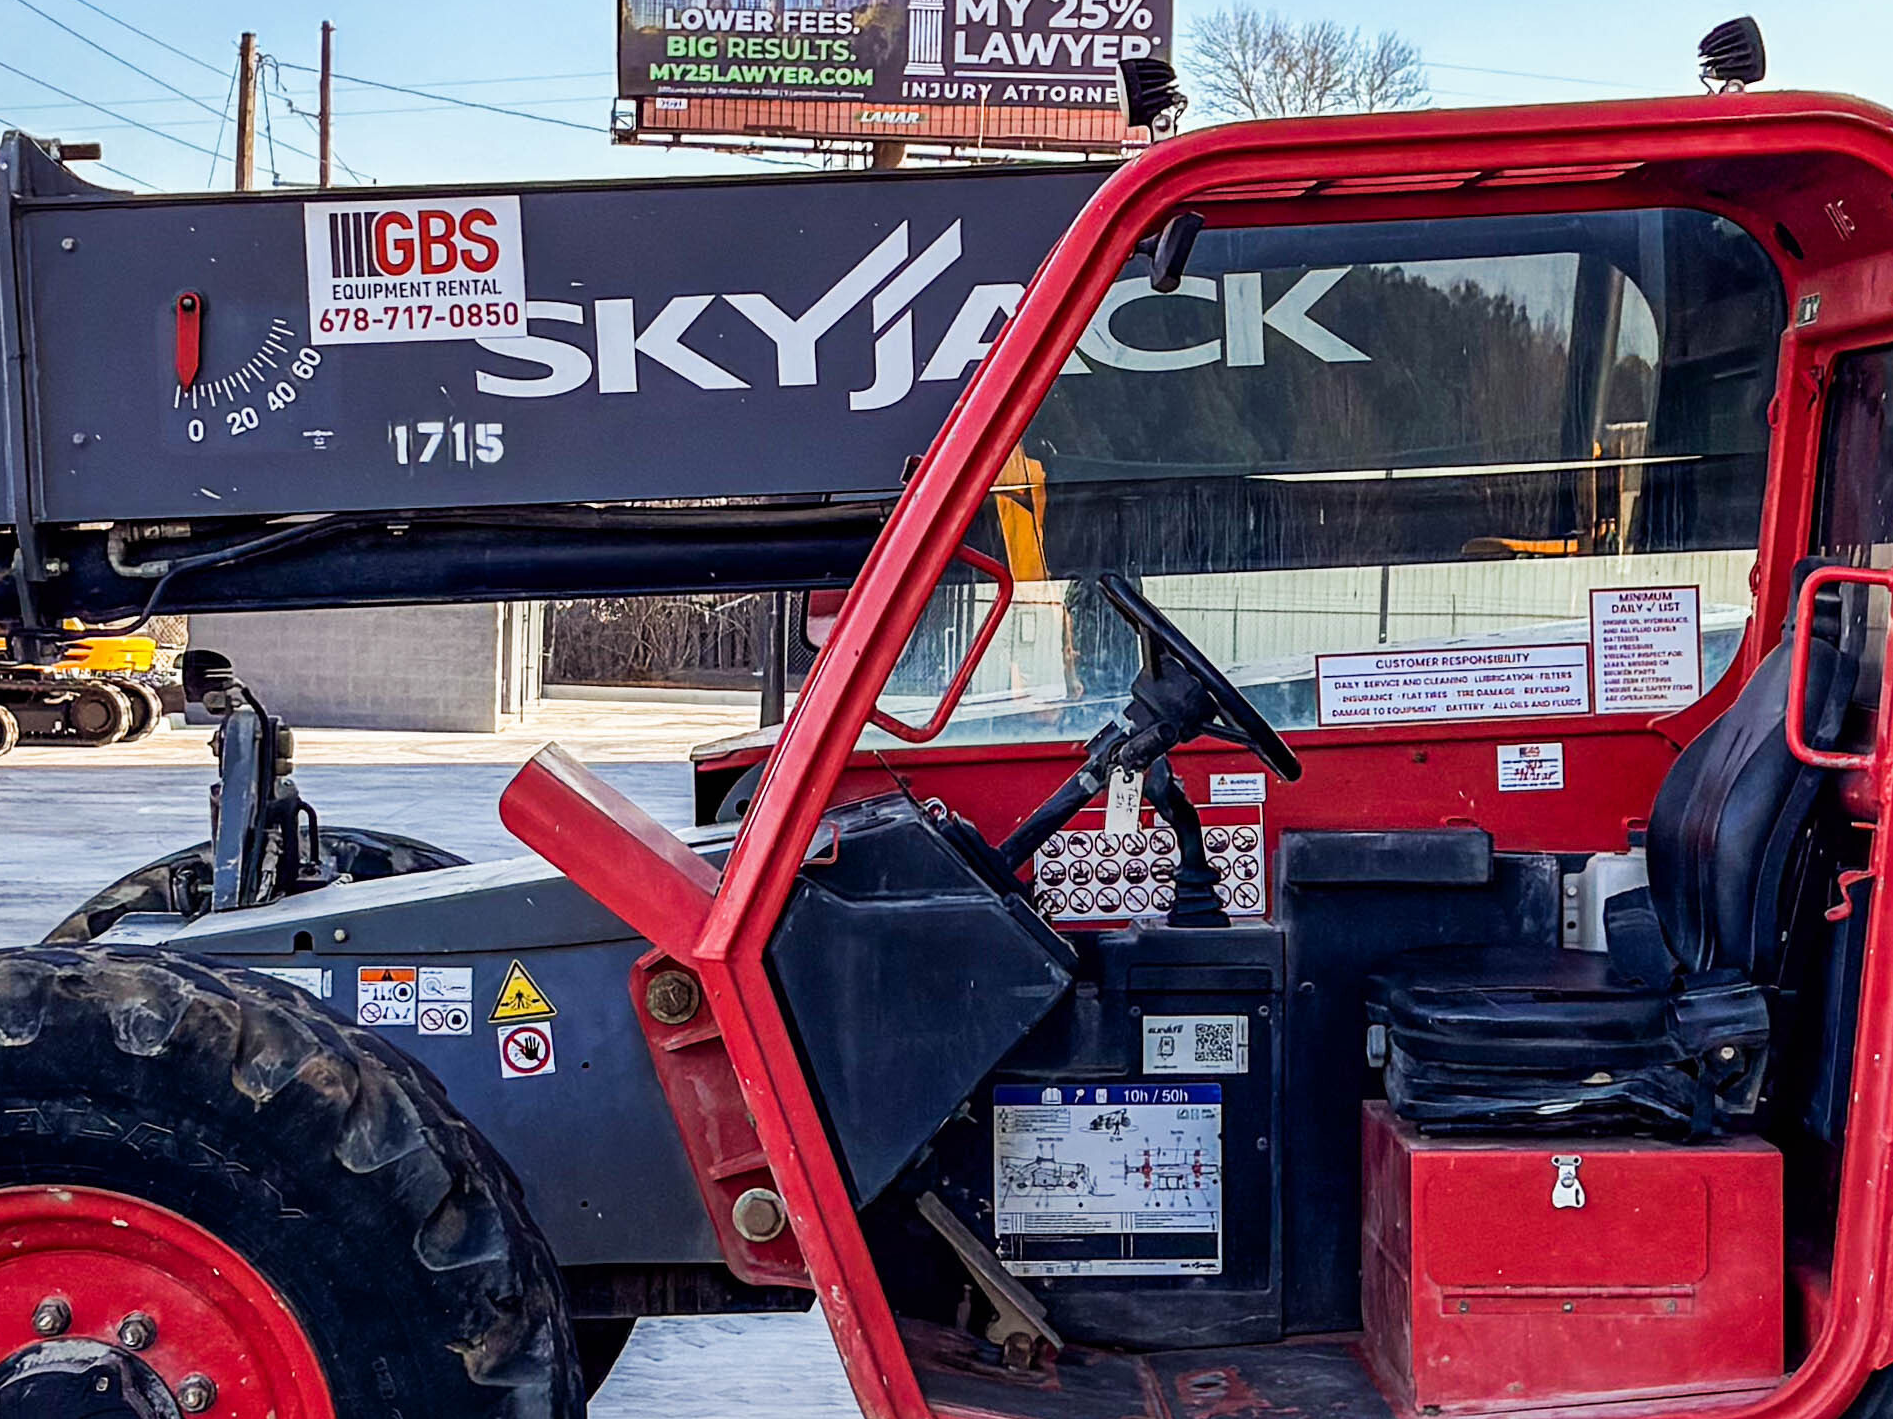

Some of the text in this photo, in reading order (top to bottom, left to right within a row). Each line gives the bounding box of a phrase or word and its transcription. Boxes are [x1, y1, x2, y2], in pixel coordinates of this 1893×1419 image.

[664, 8, 860, 35] LOWER FEES.
[666, 36, 857, 61] BIG RESULTS.
[649, 63, 874, 86] MY25LAWYER.COM
[901, 81, 1118, 104] INJURY ATTORNE
[860, 110, 919, 124] LAMAR
[372, 208, 499, 276] GBS
[333, 279, 502, 300] EQUIPMENT RENTAL
[319, 302, 519, 333] 678-717-0850
[475, 219, 1372, 411] SKYJACK
[291, 347, 321, 380] 60
[267, 381, 296, 412] 40
[188, 419, 204, 442] 0
[226, 406, 259, 436] 20
[394, 421, 505, 465] 1715
[1611, 602, 1680, 613] DAILY LIST
[1619, 592, 1672, 601] MINIMUM
[1376, 653, 1530, 669] CUSTOMER RESPONSIBILITY
[1364, 679, 1399, 688] SERVICE
[1403, 678, 1421, 686] AND
[1424, 676, 1468, 685] CLEANING
[1475, 673, 1533, 683] LUBRICATION
[1343, 693, 1393, 702] INSURANCE
[1477, 687, 1515, 696] DAMAGE
[1332, 708, 1370, 717] DAMAGE
[1374, 707, 1385, 715] TO
[1387, 705, 1437, 715] EQUIPMENT
[1446, 703, 1485, 712] BATTERY
[1493, 702, 1508, 710] ALL
[1531, 700, 1550, 708] AND
[1552, 698, 1582, 707] FLUIDS
[1124, 1089, 1148, 1103] 10h
[1162, 1088, 1188, 1103] 50h
